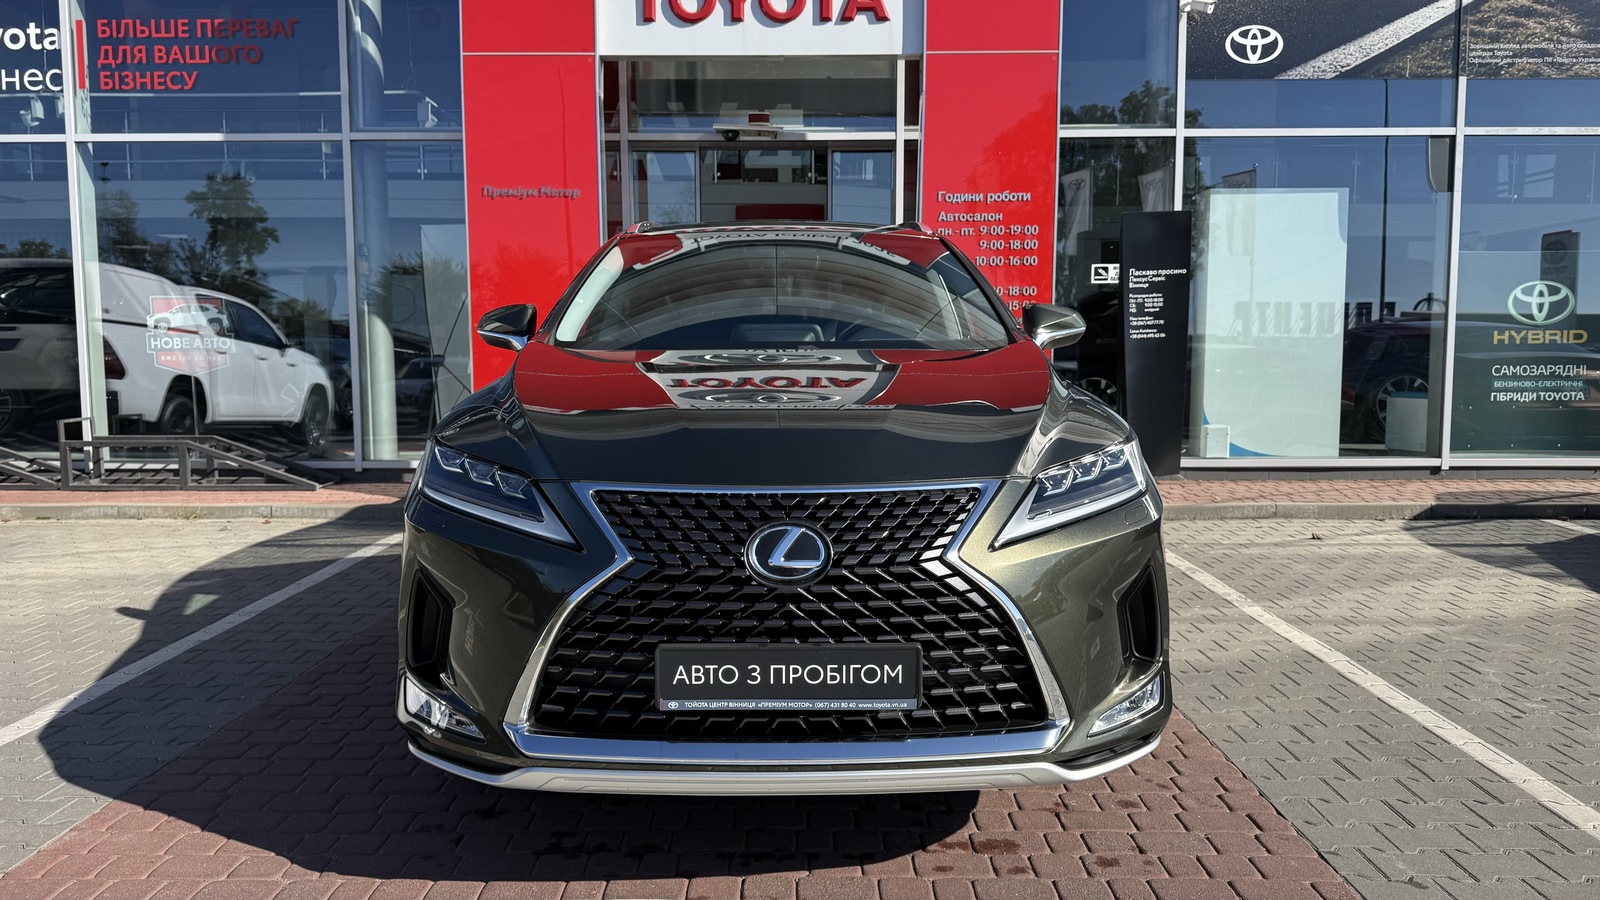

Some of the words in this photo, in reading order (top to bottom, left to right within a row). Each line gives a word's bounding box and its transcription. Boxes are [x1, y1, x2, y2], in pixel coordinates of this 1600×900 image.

[97, 19, 189, 38] БІЛЬШЕ
[196, 18, 300, 38] ПЕРЕВАГ
[97, 45, 147, 68] ДЛЯ
[154, 45, 262, 64] ВАШОГО
[99, 71, 198, 90] БІЗНЕСУ
[482, 185, 538, 199] Преміум
[540, 186, 581, 200] Мотор
[938, 191, 983, 203] Години
[987, 190, 1031, 204] роботи
[938, 211, 1003, 221] Автосалон
[980, 225, 1039, 235] 9:00-19:00
[979, 239, 1038, 250] 9:00-18:00
[975, 256, 1038, 266] 10:00-16:00
[1493, 329, 1588, 344] HYBRID
[150, 337, 190, 349] НОВЕ
[193, 337, 231, 349] АВТО
[1492, 365, 1587, 377] САМОЗАРЯДНІ
[1494, 380, 1583, 388] БЕНЗИНОВО-ЕЛЕКТРИЧНІ
[1491, 392, 1537, 402] ГІБРИДИ
[1538, 391, 1585, 401] TOYOTA
[672, 664, 739, 685] АВТО
[746, 664, 761, 685] З
[770, 664, 903, 685] ПРОБІГОМ
